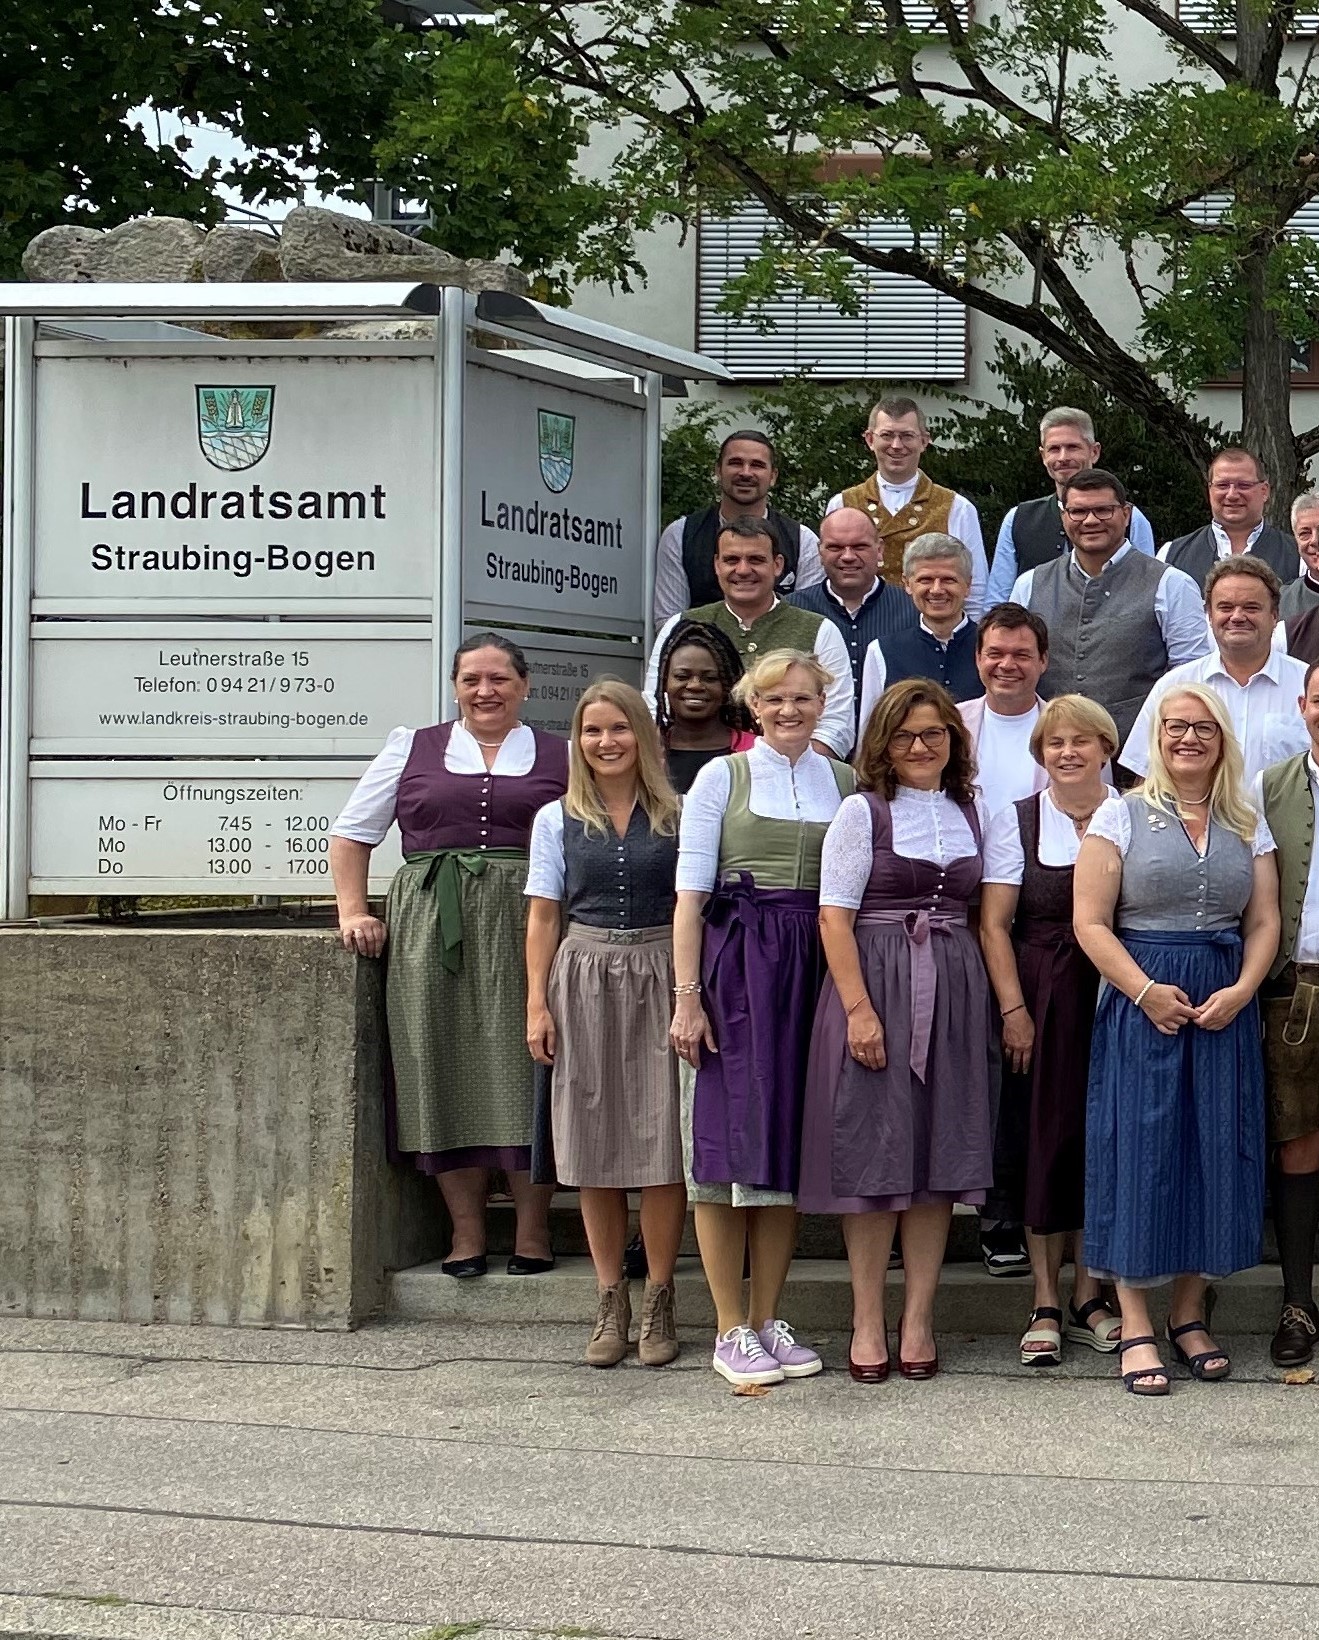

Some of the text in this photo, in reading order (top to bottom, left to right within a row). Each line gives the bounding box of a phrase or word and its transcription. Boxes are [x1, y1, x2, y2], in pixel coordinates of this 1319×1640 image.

[82, 483, 386, 519] Landratsamt
[481, 490, 623, 549] Landratsamt
[92, 544, 374, 577] Straubing-Bogen
[487, 552, 617, 598] Straubing-Bogen
[159, 650, 308, 667] Leutnerstraße 15
[134, 677, 200, 694] Telefon:
[99, 711, 368, 728] www.landkreis-straubing-bogen.de
[164, 781, 303, 804] Öffnungszeiten:
[99, 816, 125, 831] Mo
[145, 816, 162, 831] Fr
[218, 816, 251, 831] 7.45
[285, 816, 329, 831] 12.00
[99, 837, 125, 852] Mo
[207, 838, 251, 852] 13.00
[285, 838, 328, 853] 16.00
[99, 859, 123, 874] Do
[207, 859, 251, 874] 13.00
[287, 859, 328, 874] 17.00
